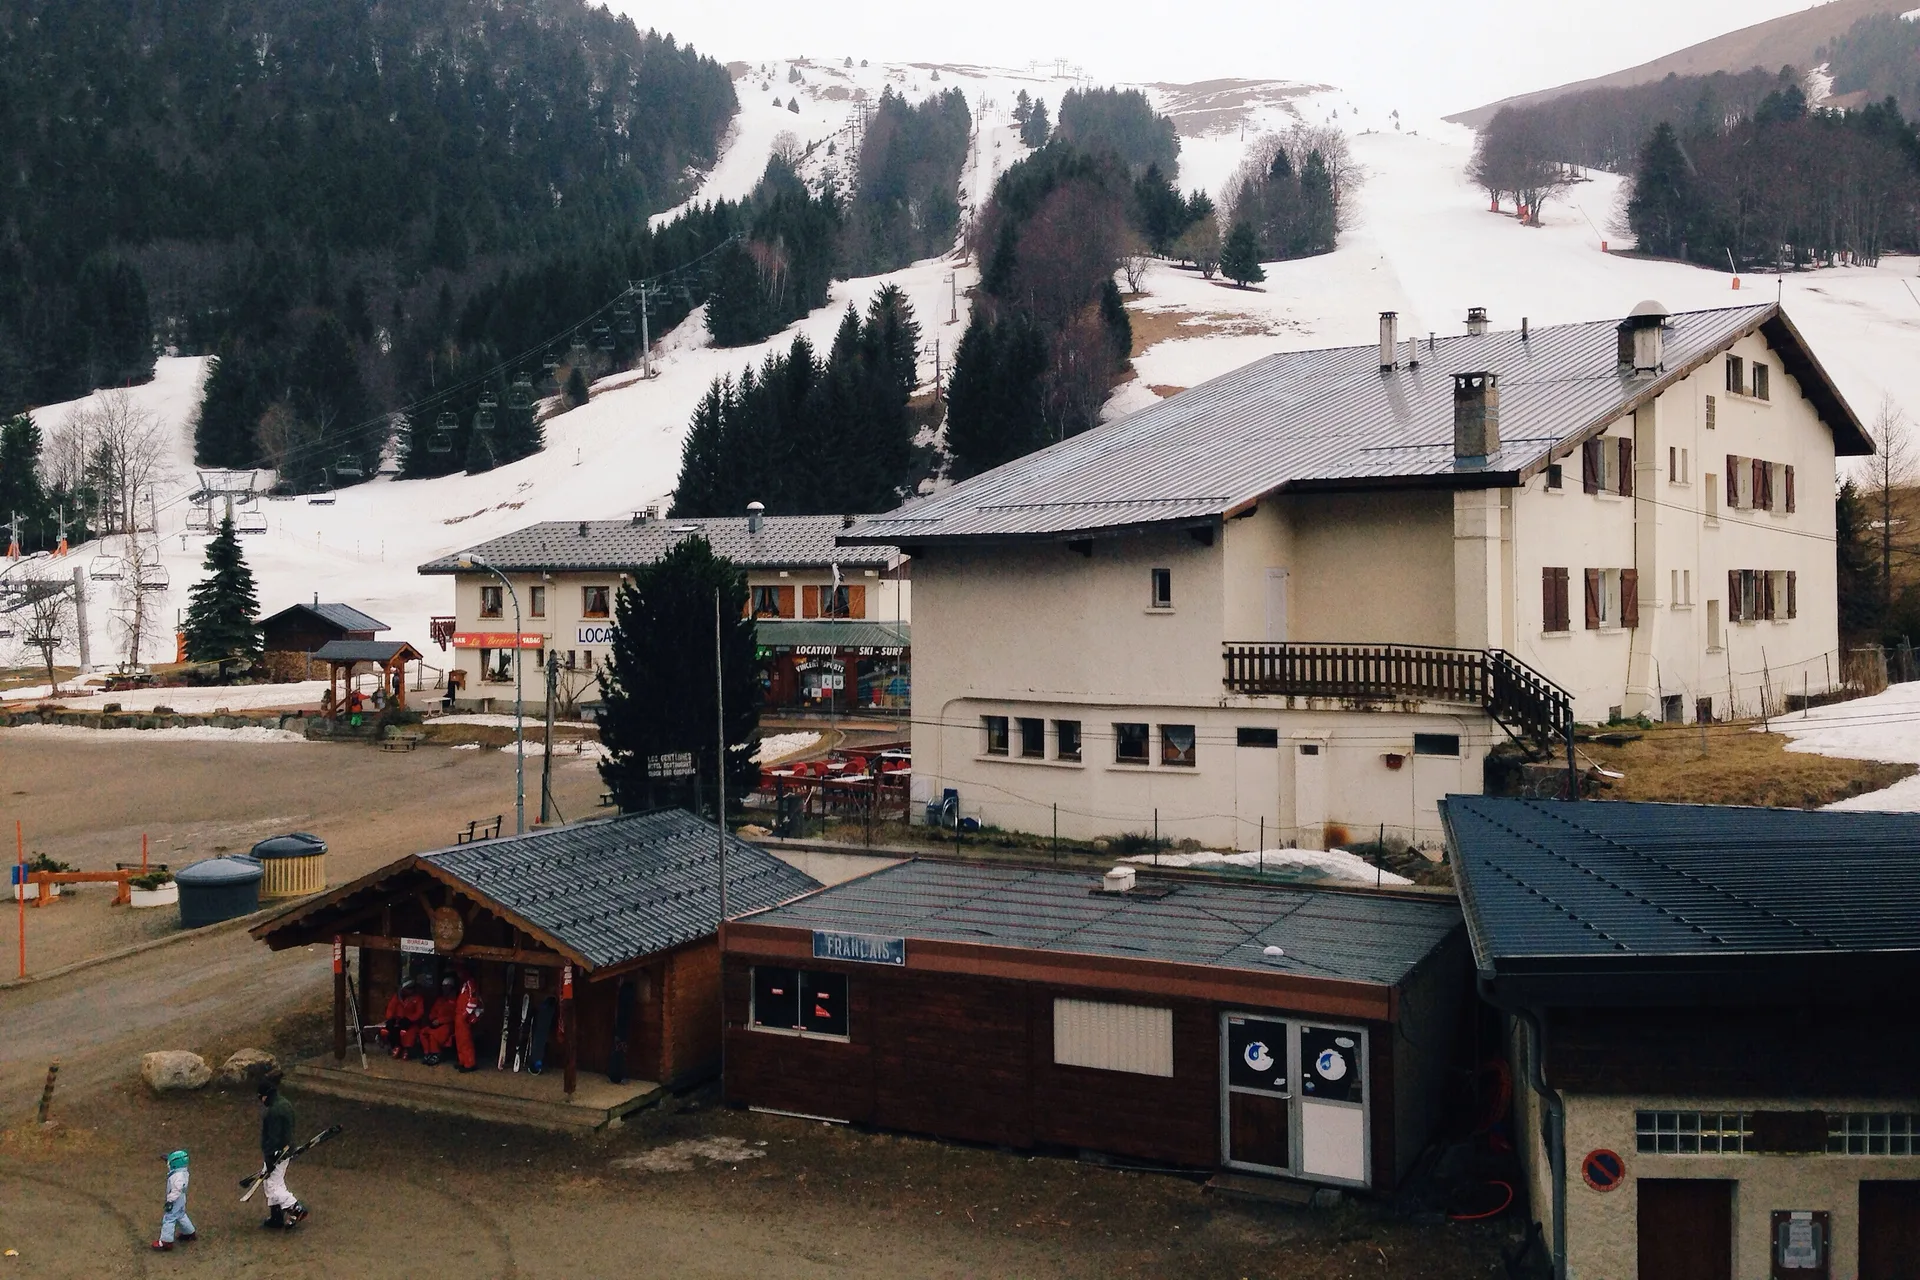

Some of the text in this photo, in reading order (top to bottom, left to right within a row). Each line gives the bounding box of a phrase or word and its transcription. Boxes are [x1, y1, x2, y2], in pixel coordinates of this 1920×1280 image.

[578, 627, 612, 643] LOCA
[796, 646, 837, 655] LOCATION
[859, 646, 873, 656] SKI
[881, 647, 904, 656] SURF
